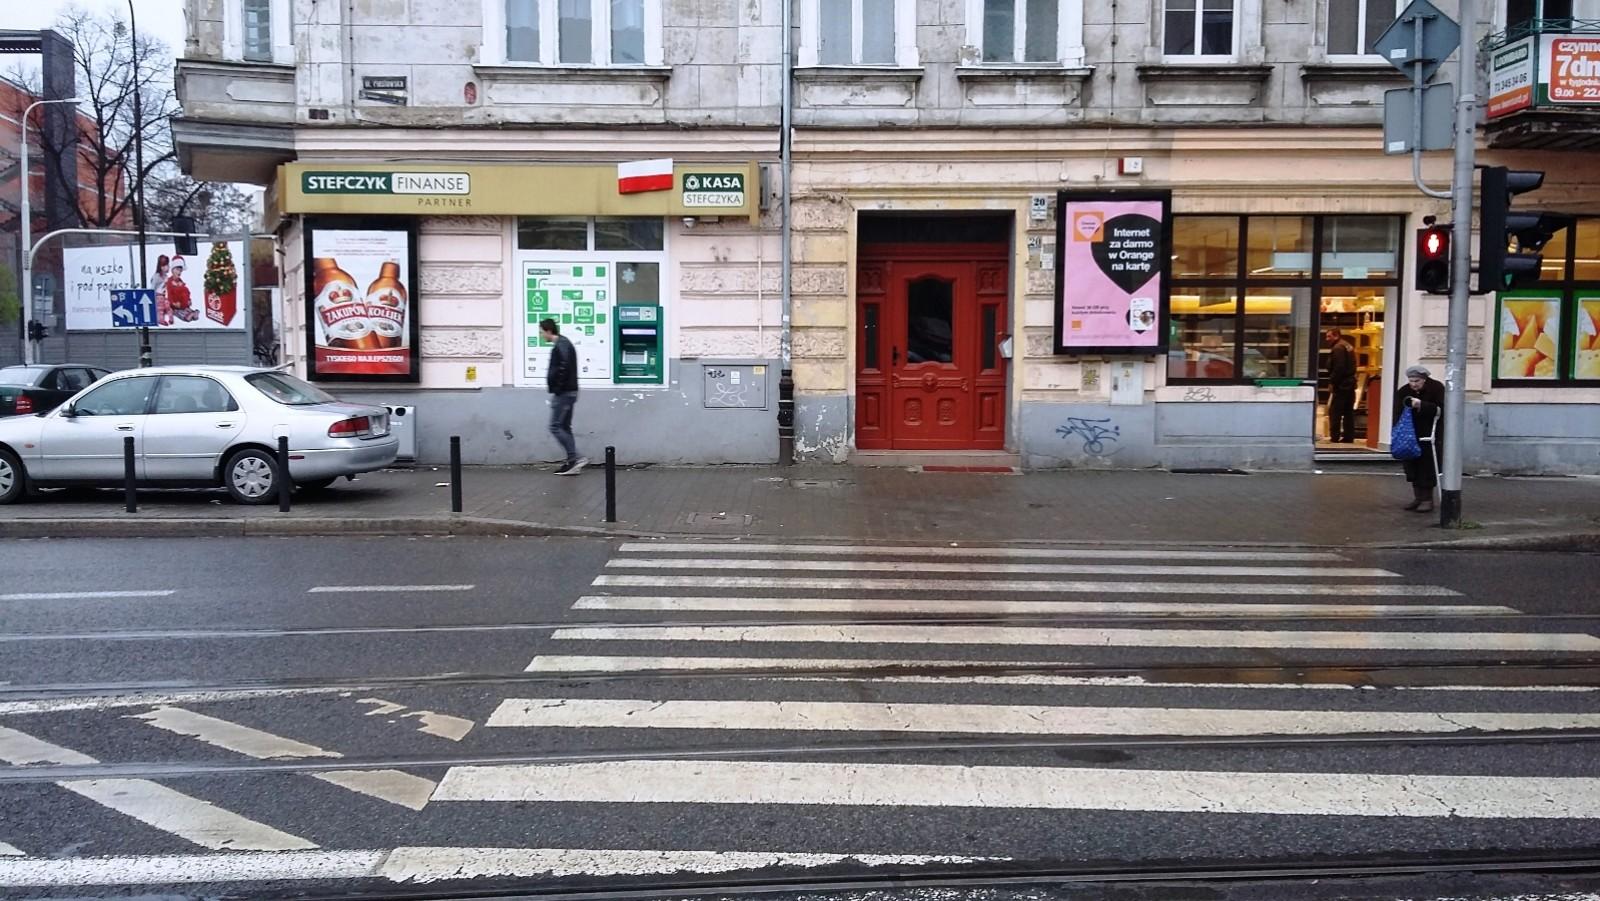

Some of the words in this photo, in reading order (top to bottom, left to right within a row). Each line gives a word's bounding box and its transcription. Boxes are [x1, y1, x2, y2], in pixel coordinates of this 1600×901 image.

[308, 176, 387, 190] STEFCZYK
[397, 176, 463, 191] FINANSE
[702, 177, 741, 188] KASA
[418, 198, 472, 207] PARTNER
[686, 194, 741, 204] STEFCZYKA
[1034, 198, 1046, 207] 20
[1113, 228, 1151, 237] Internet
[1109, 241, 1121, 249] za
[1122, 240, 1154, 249] darmo
[1108, 251, 1118, 259] w
[1119, 250, 1155, 261] Orange
[1111, 263, 1124, 271] na
[1125, 262, 1151, 272] kartę
[324, 355, 356, 363] TYSKIEGO
